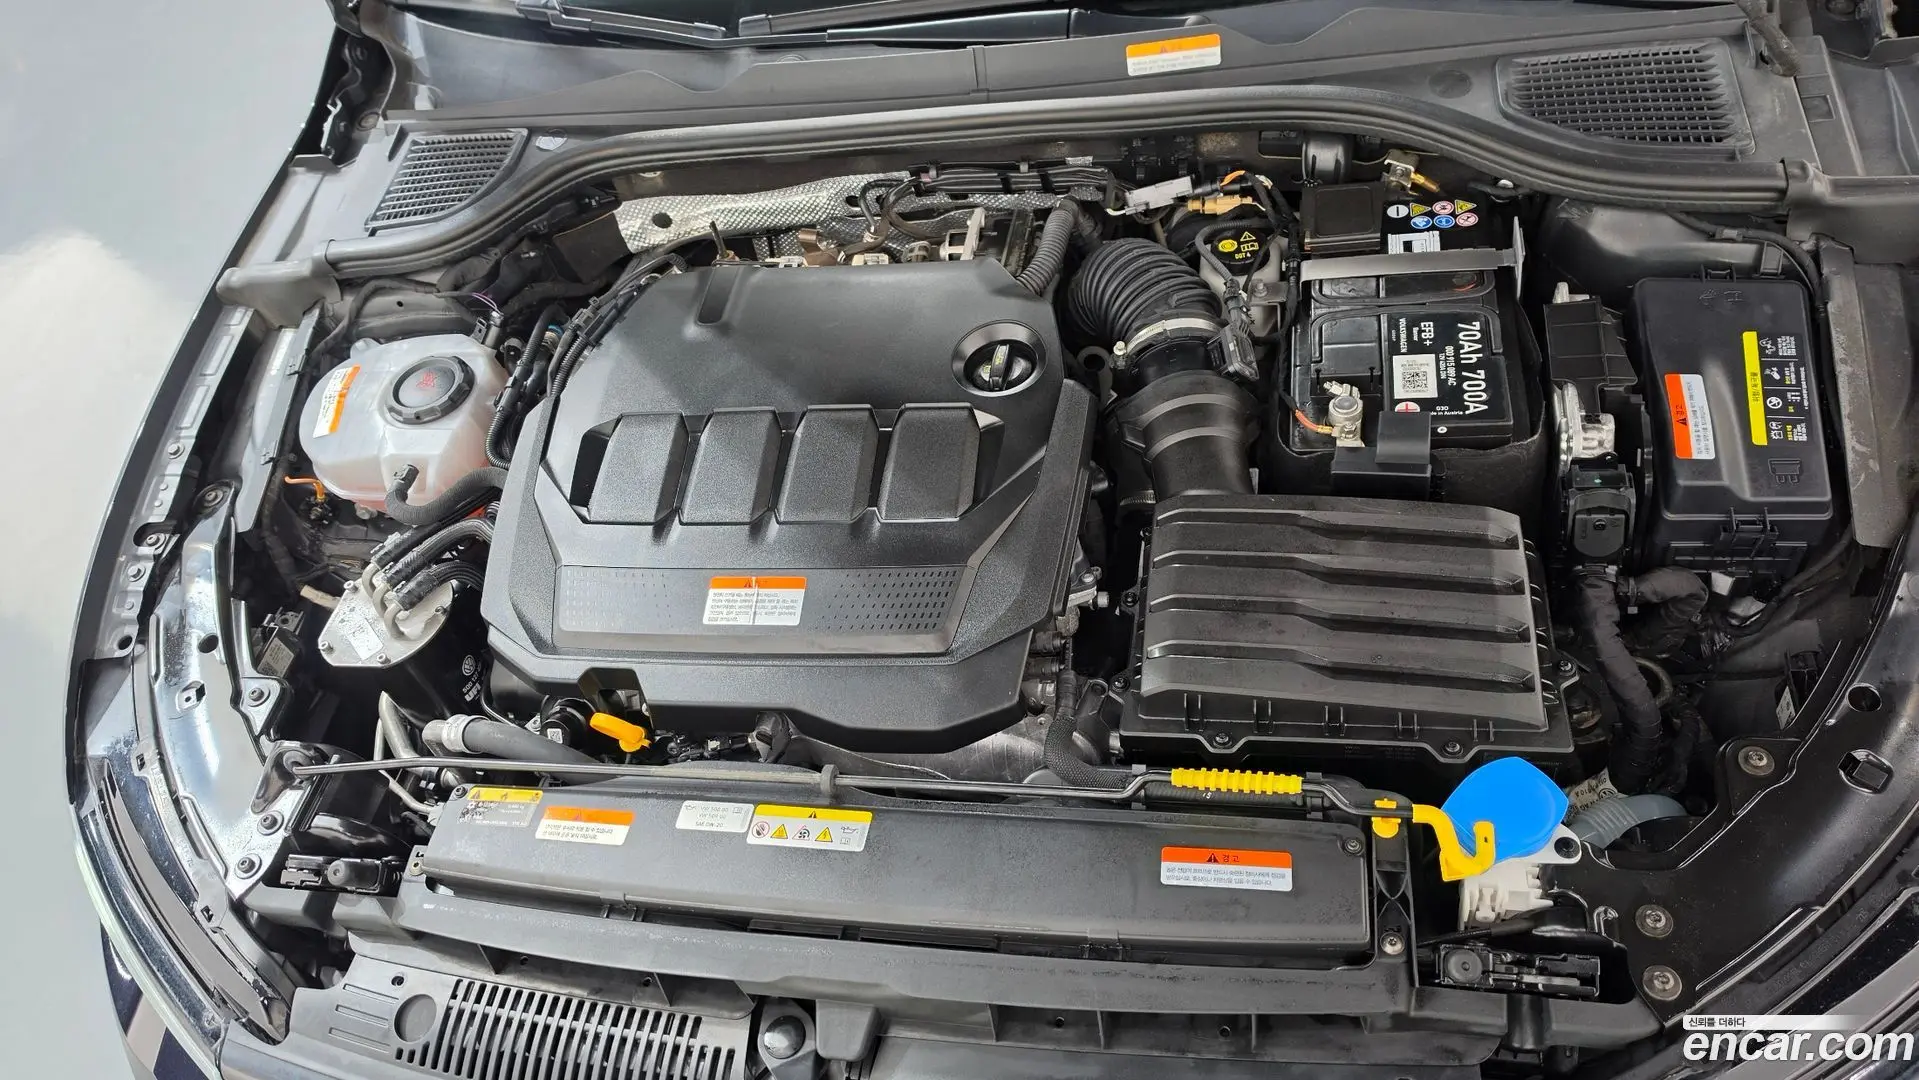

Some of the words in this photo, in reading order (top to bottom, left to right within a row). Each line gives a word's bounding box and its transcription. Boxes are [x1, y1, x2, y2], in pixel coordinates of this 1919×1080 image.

[1400, 318, 1408, 352] VOLKSWAGEN
[1421, 322, 1434, 346] EFB+
[1458, 322, 1483, 364] 70Ah
[1462, 370, 1488, 414] 700A
[464, 682, 481, 701] UFI
